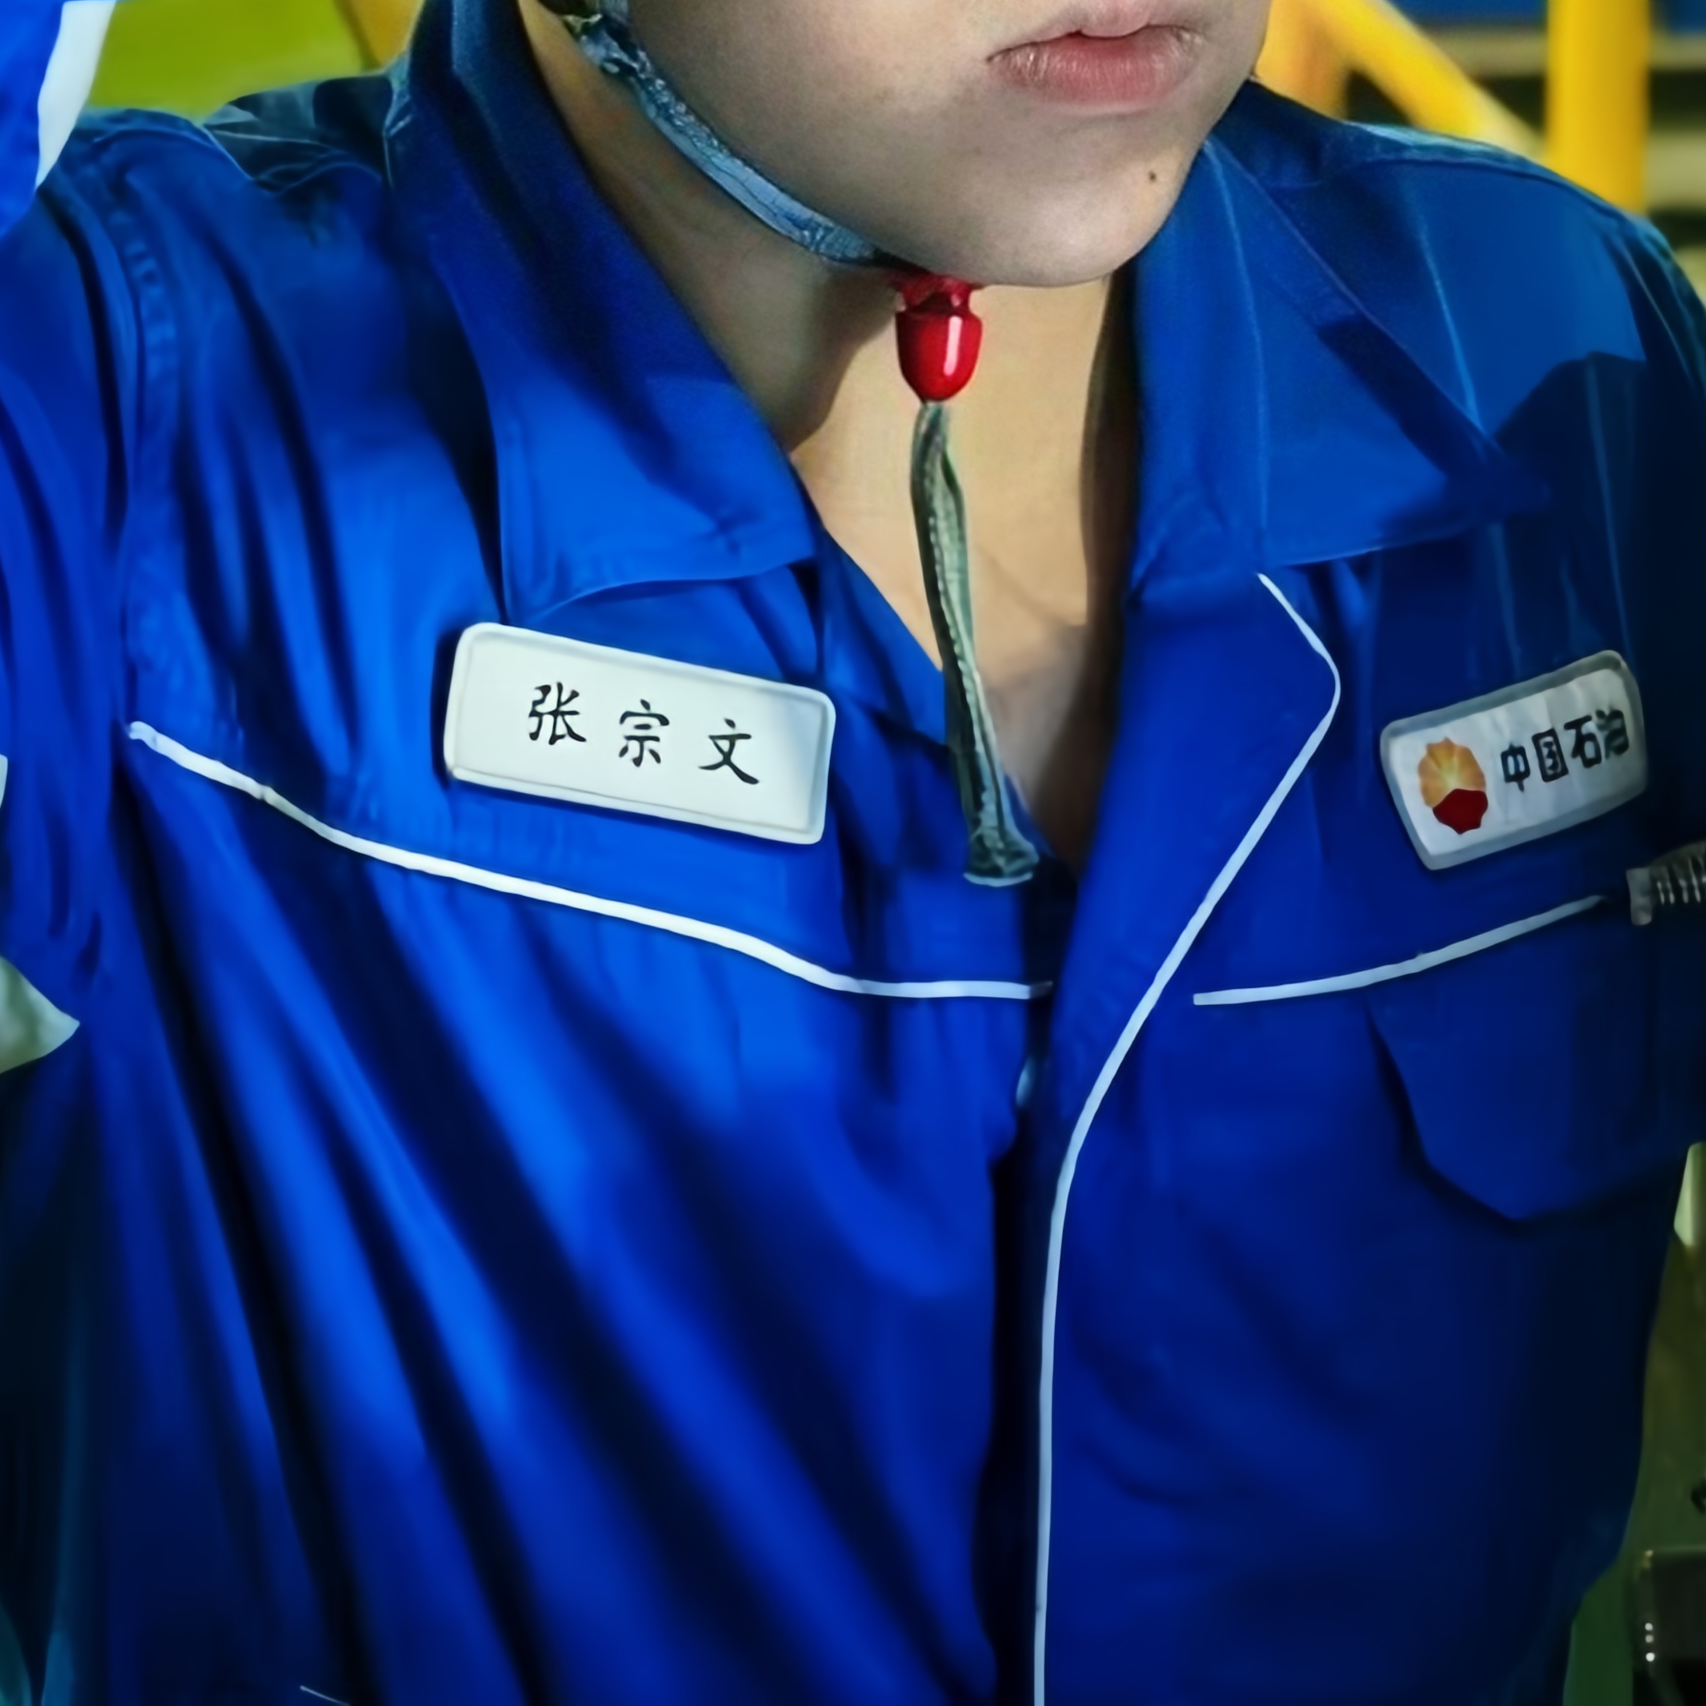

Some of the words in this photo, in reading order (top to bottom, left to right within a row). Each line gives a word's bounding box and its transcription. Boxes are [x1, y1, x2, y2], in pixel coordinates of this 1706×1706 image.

[528, 681, 760, 786] 张宗文
[1499, 707, 1630, 793] 中国石油
